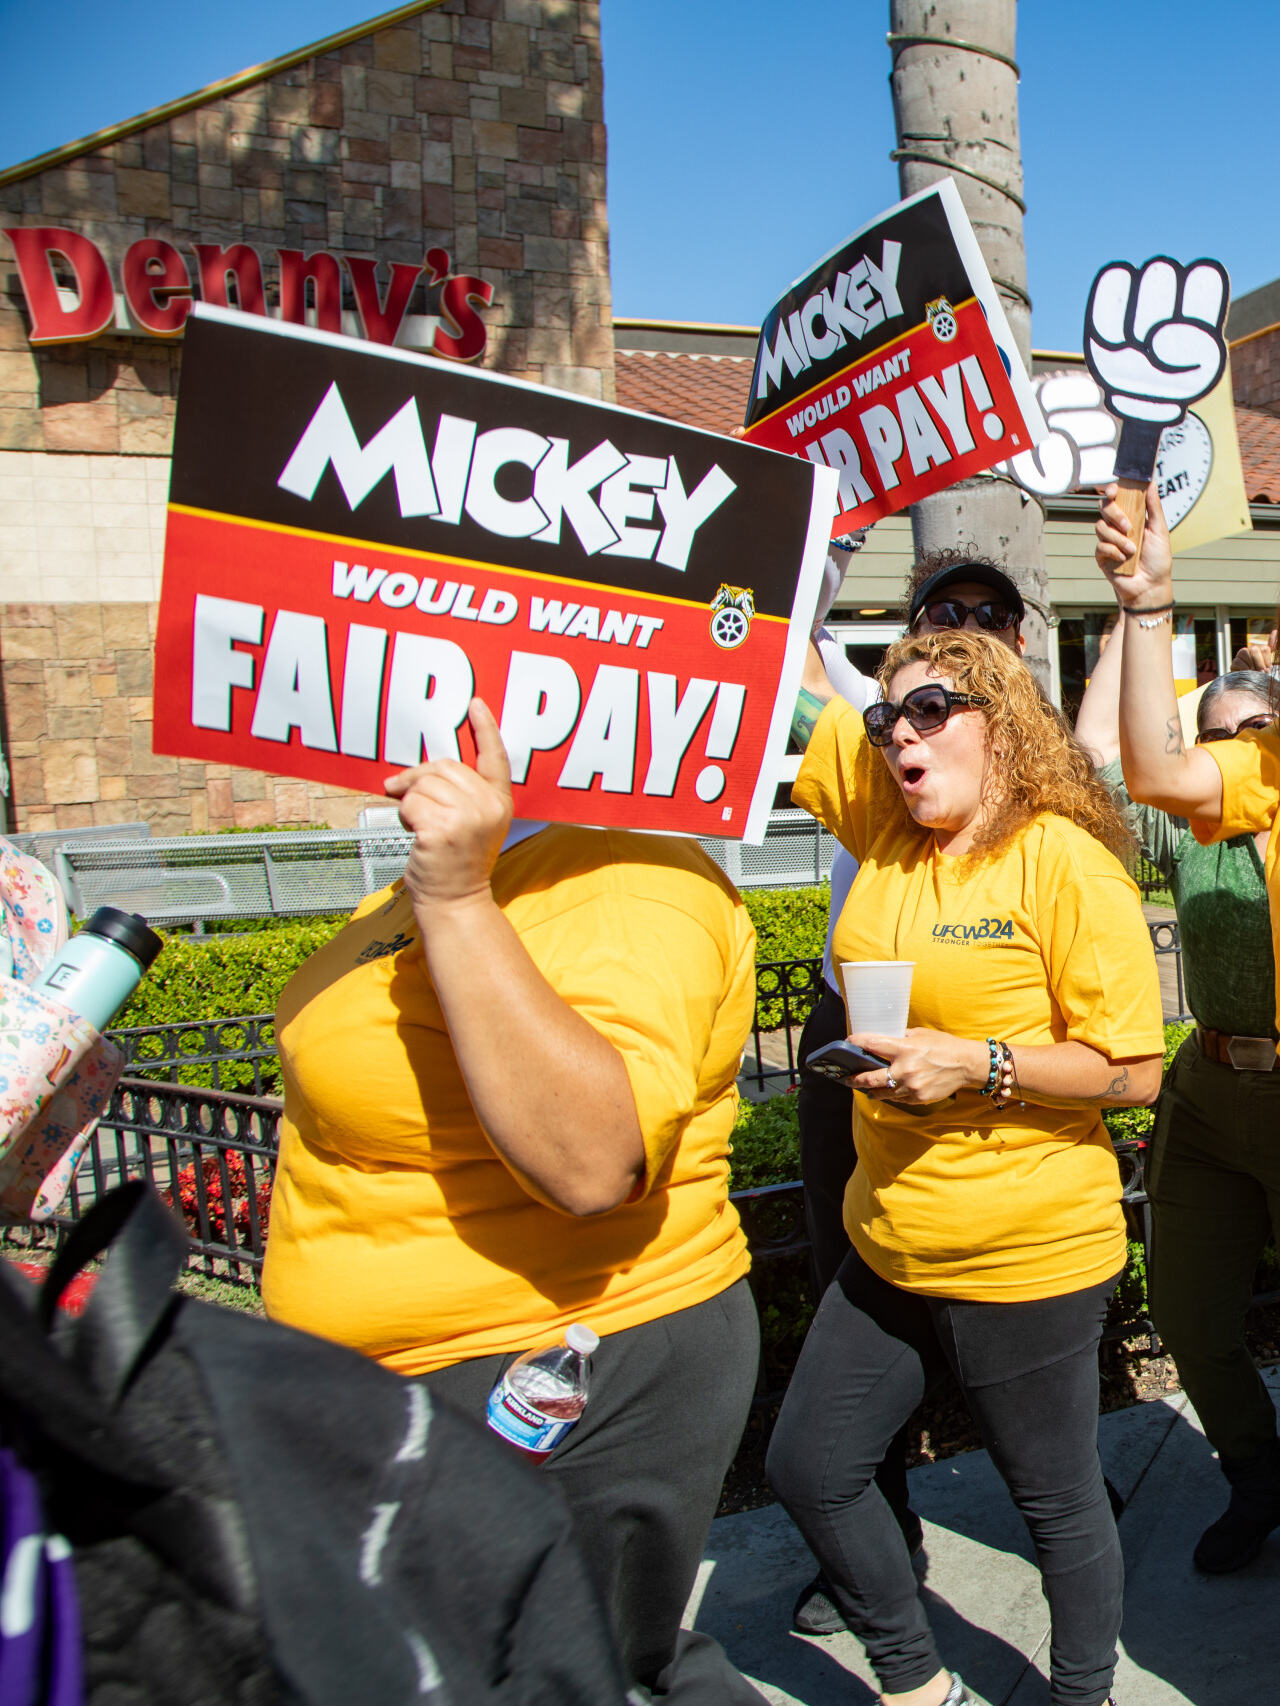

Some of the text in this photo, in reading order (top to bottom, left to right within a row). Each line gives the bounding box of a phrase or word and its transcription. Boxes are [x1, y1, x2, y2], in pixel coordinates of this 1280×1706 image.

[2, 226, 495, 364] Denny's
[757, 239, 905, 399] MICKEY
[786, 348, 911, 438] WOULD WANT
[859, 354, 1005, 491] PAY!
[277, 380, 738, 572] MICKEY
[333, 560, 665, 648] WOULD WANT
[191, 593, 746, 803] FAIR PAY!
[932, 937, 970, 946] STRONGER
[505, 1394, 544, 1426] KIRKLAND
